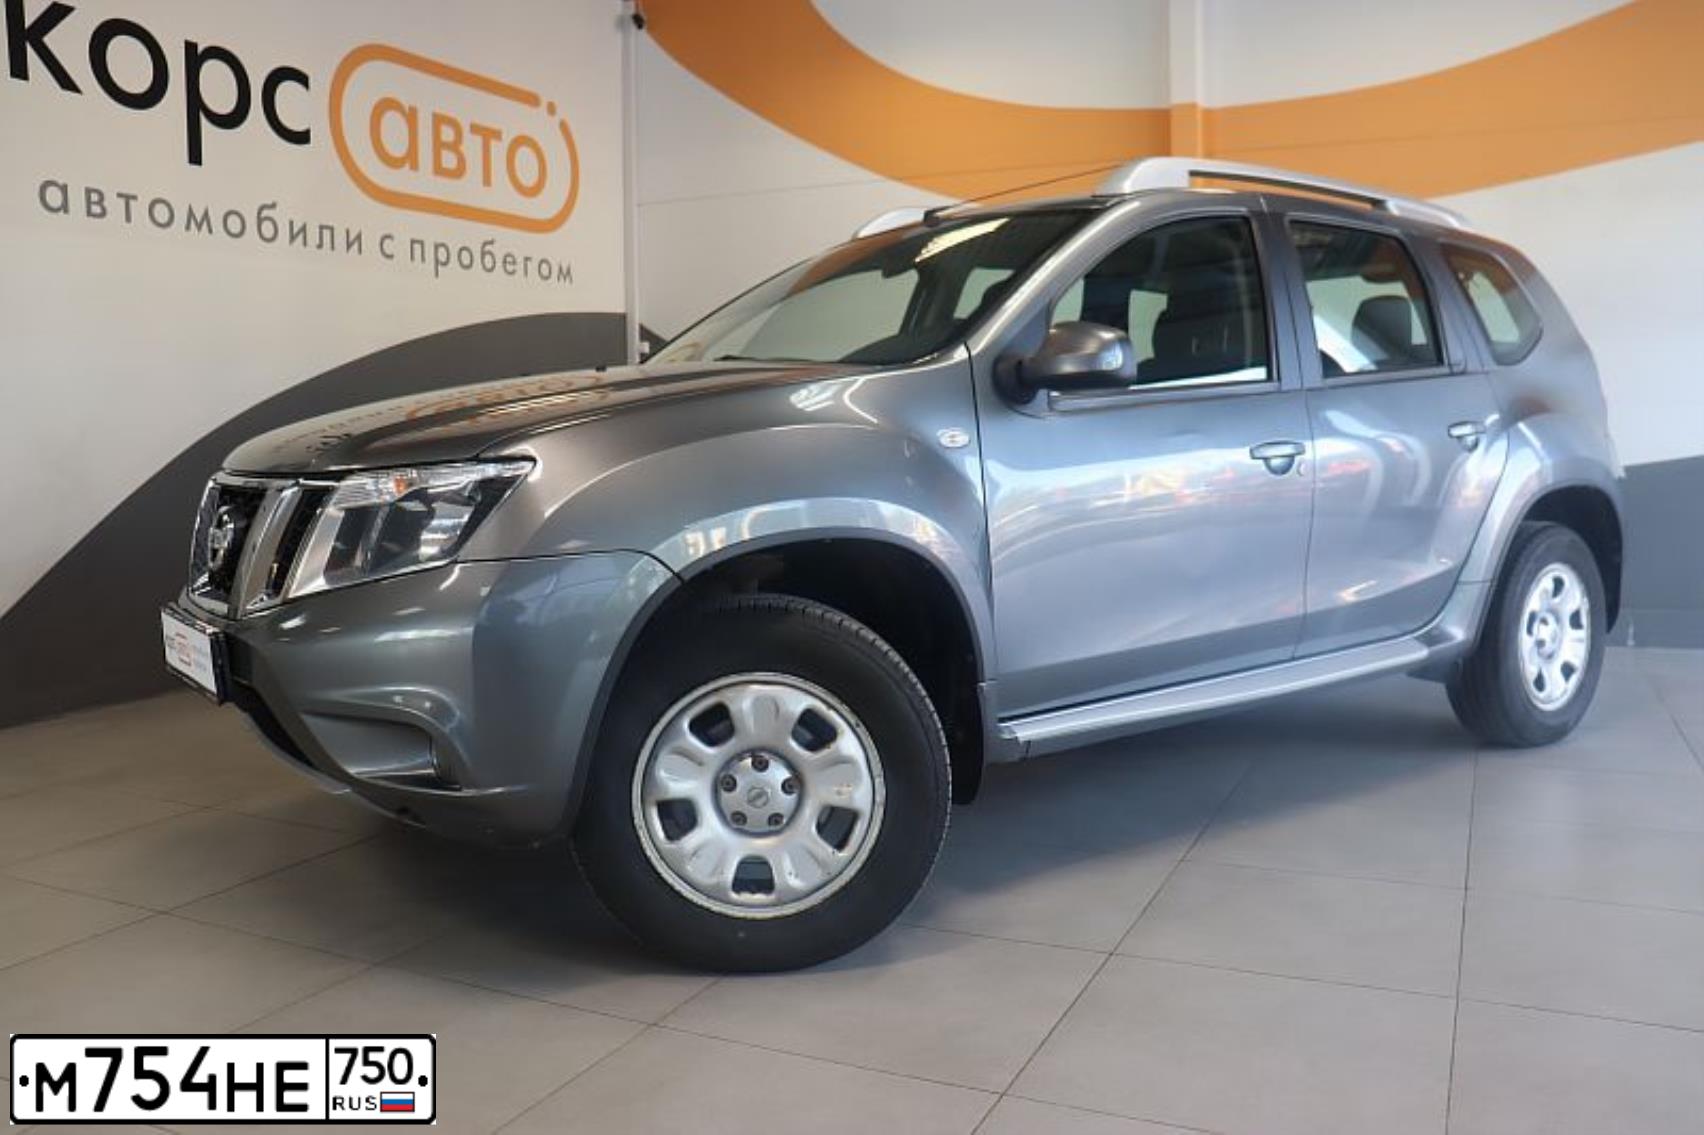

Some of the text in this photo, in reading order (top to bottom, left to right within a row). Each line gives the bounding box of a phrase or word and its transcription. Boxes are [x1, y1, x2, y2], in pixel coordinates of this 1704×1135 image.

[4, 0, 548, 199] корс авто
[38, 178, 574, 284] автомобили с пробегом
